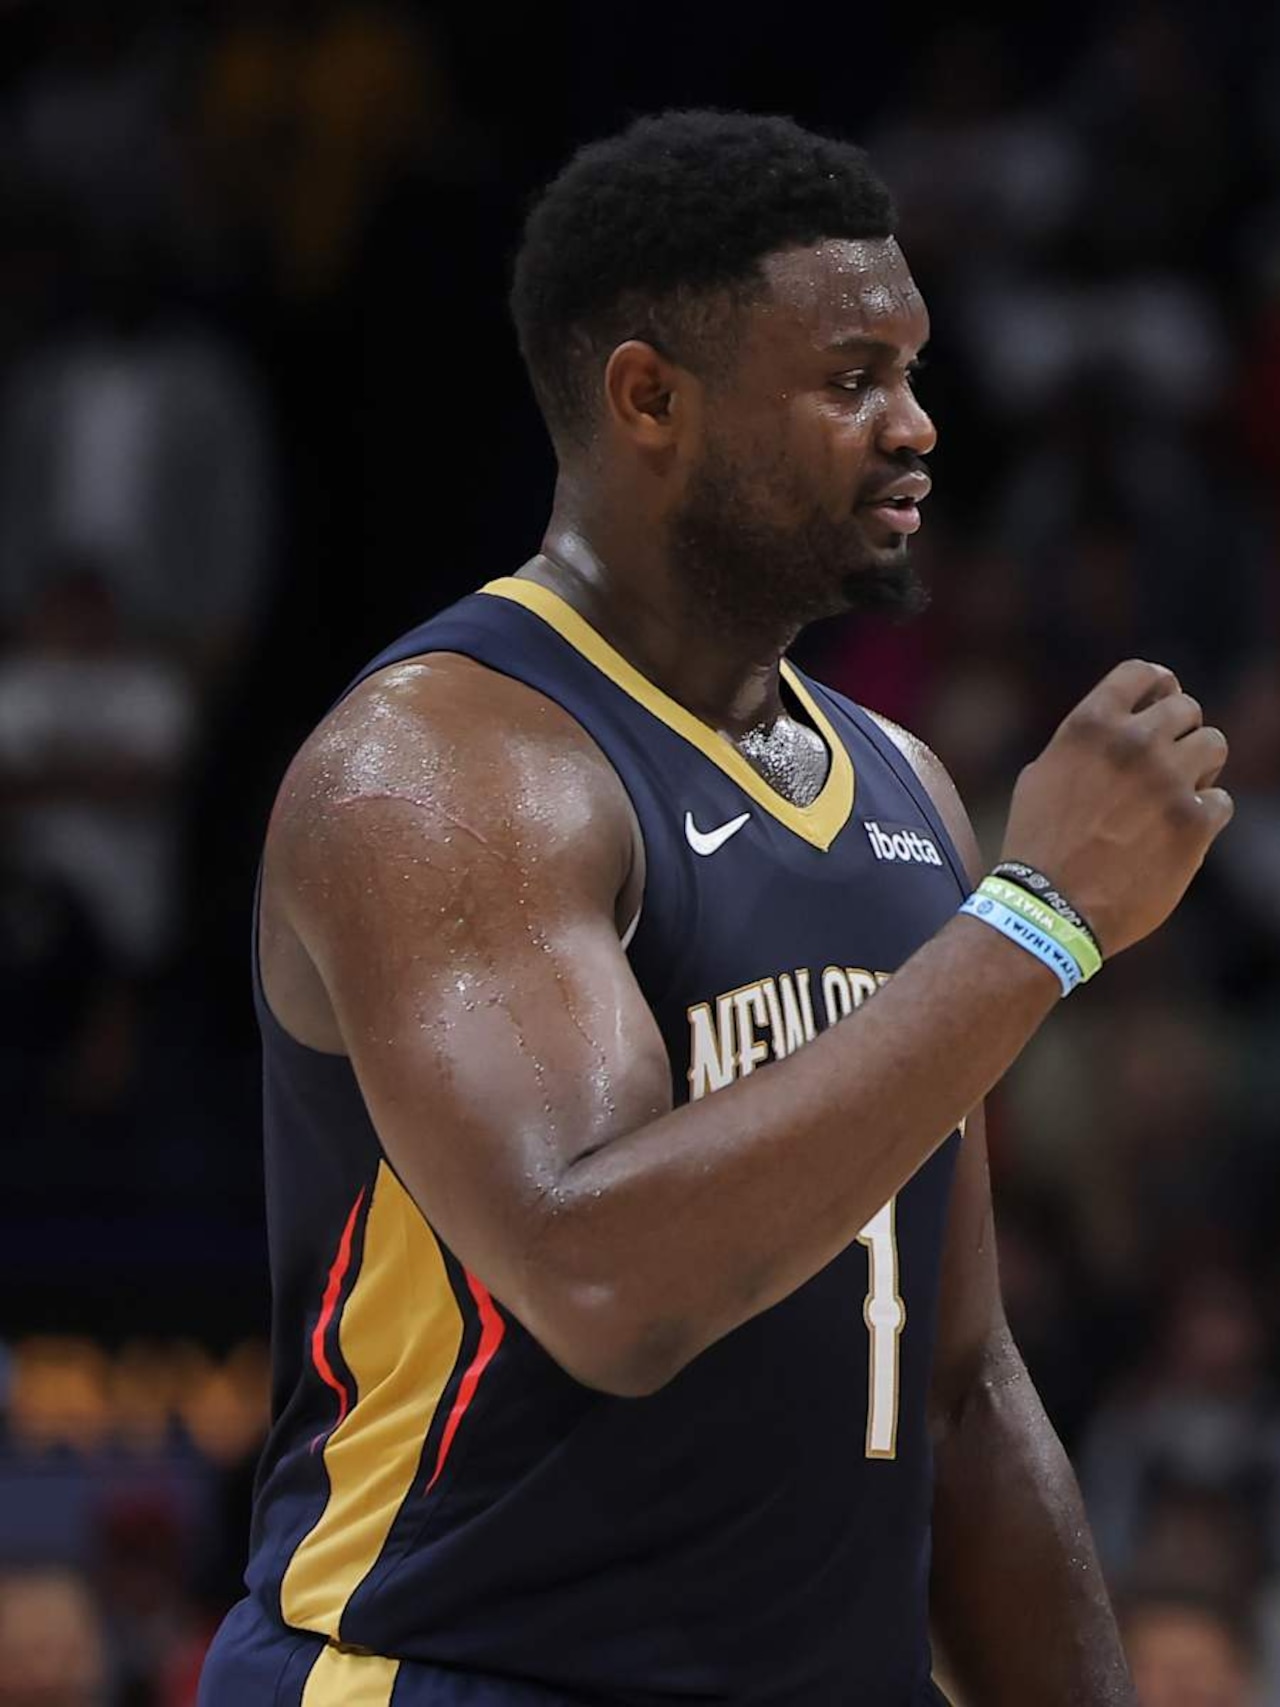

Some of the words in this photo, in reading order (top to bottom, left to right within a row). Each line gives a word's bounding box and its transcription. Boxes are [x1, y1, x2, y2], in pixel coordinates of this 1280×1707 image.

[863, 821, 943, 866] ibotta
[687, 965, 818, 1101] NEW
[855, 1191, 907, 1460] 1
